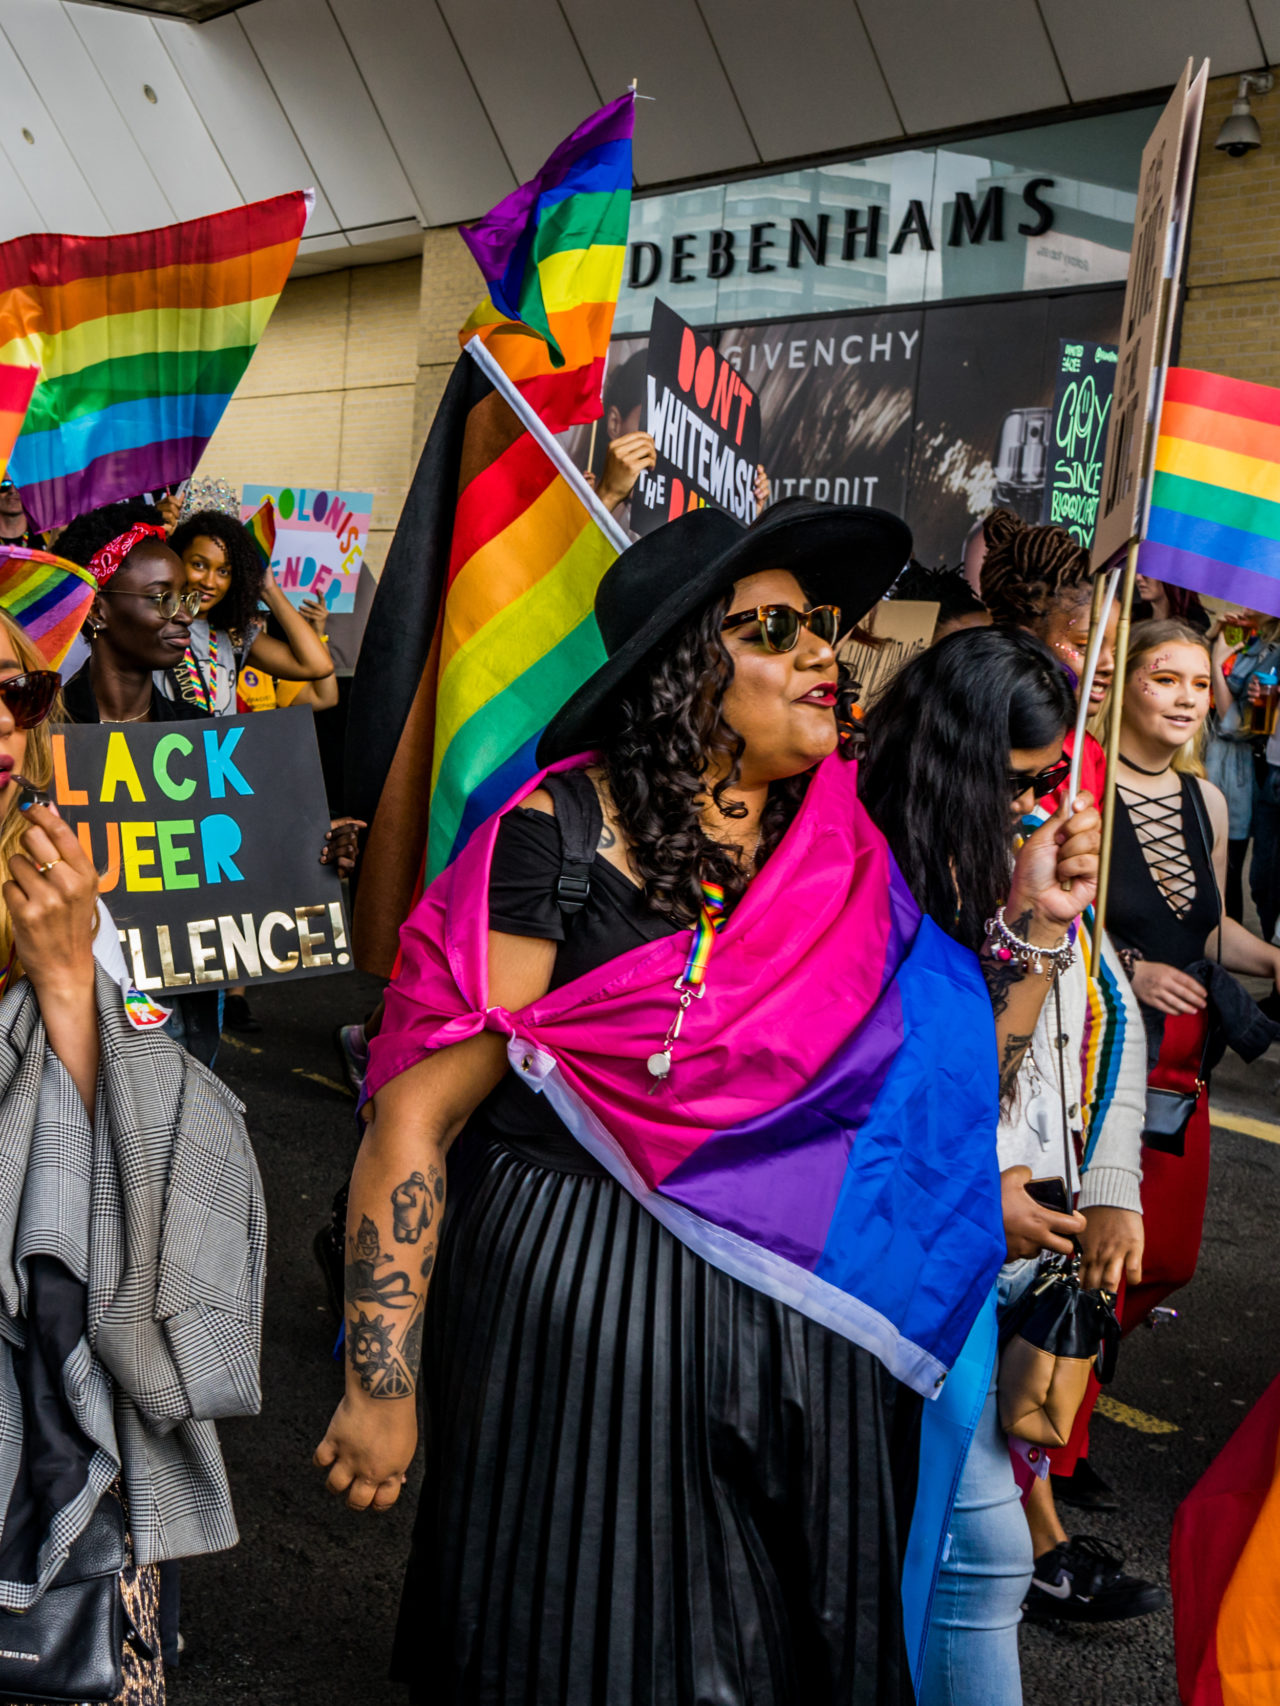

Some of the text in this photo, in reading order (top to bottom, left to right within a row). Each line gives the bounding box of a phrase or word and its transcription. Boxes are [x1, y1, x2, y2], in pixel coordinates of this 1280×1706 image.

[627, 178, 1056, 289] DEBENHAMS
[677, 326, 754, 447] DON'T
[723, 329, 920, 372] GIVENCHY
[647, 374, 758, 526] WHITEWASH
[1055, 375, 1113, 464] GAY
[638, 468, 666, 510] THE
[1053, 459, 1102, 495] SINCE
[51, 726, 255, 806] LACK
[77, 813, 246, 894] UEER
[118, 901, 351, 992] LLENCE!
